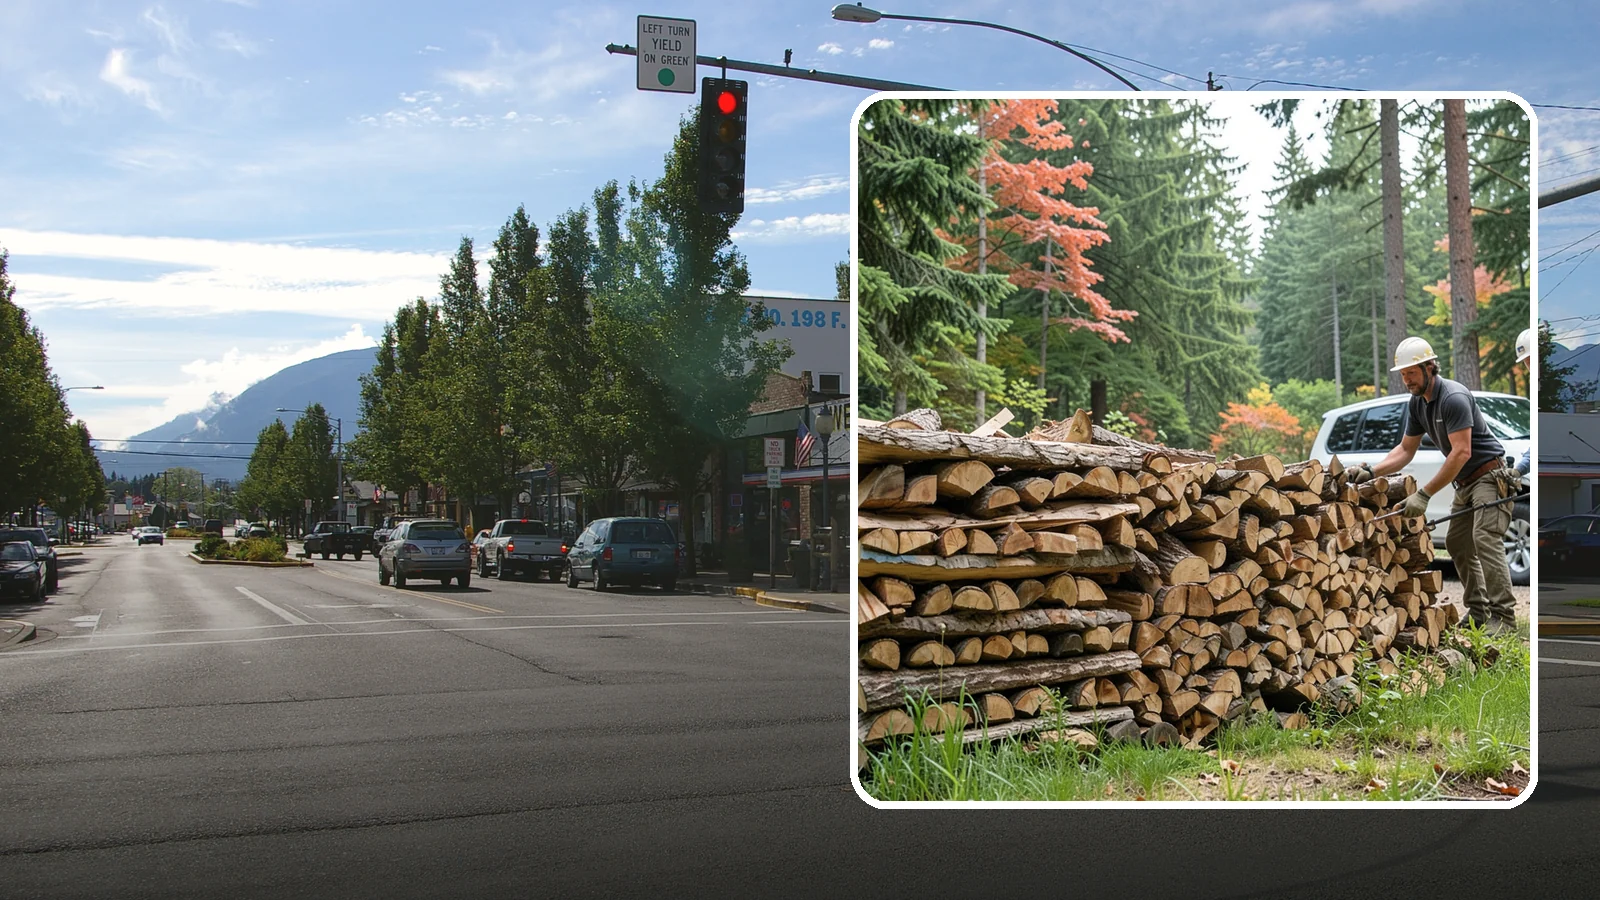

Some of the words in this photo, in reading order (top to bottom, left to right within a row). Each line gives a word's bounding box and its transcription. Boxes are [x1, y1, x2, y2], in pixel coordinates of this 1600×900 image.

[643, 23, 663, 34] LEFT
[668, 25, 690, 37] TURN
[652, 38, 682, 52] YIELD
[644, 53, 656, 64] ON
[661, 54, 688, 66] GREEN
[791, 309, 826, 329] 198
[831, 311, 847, 329] F.
